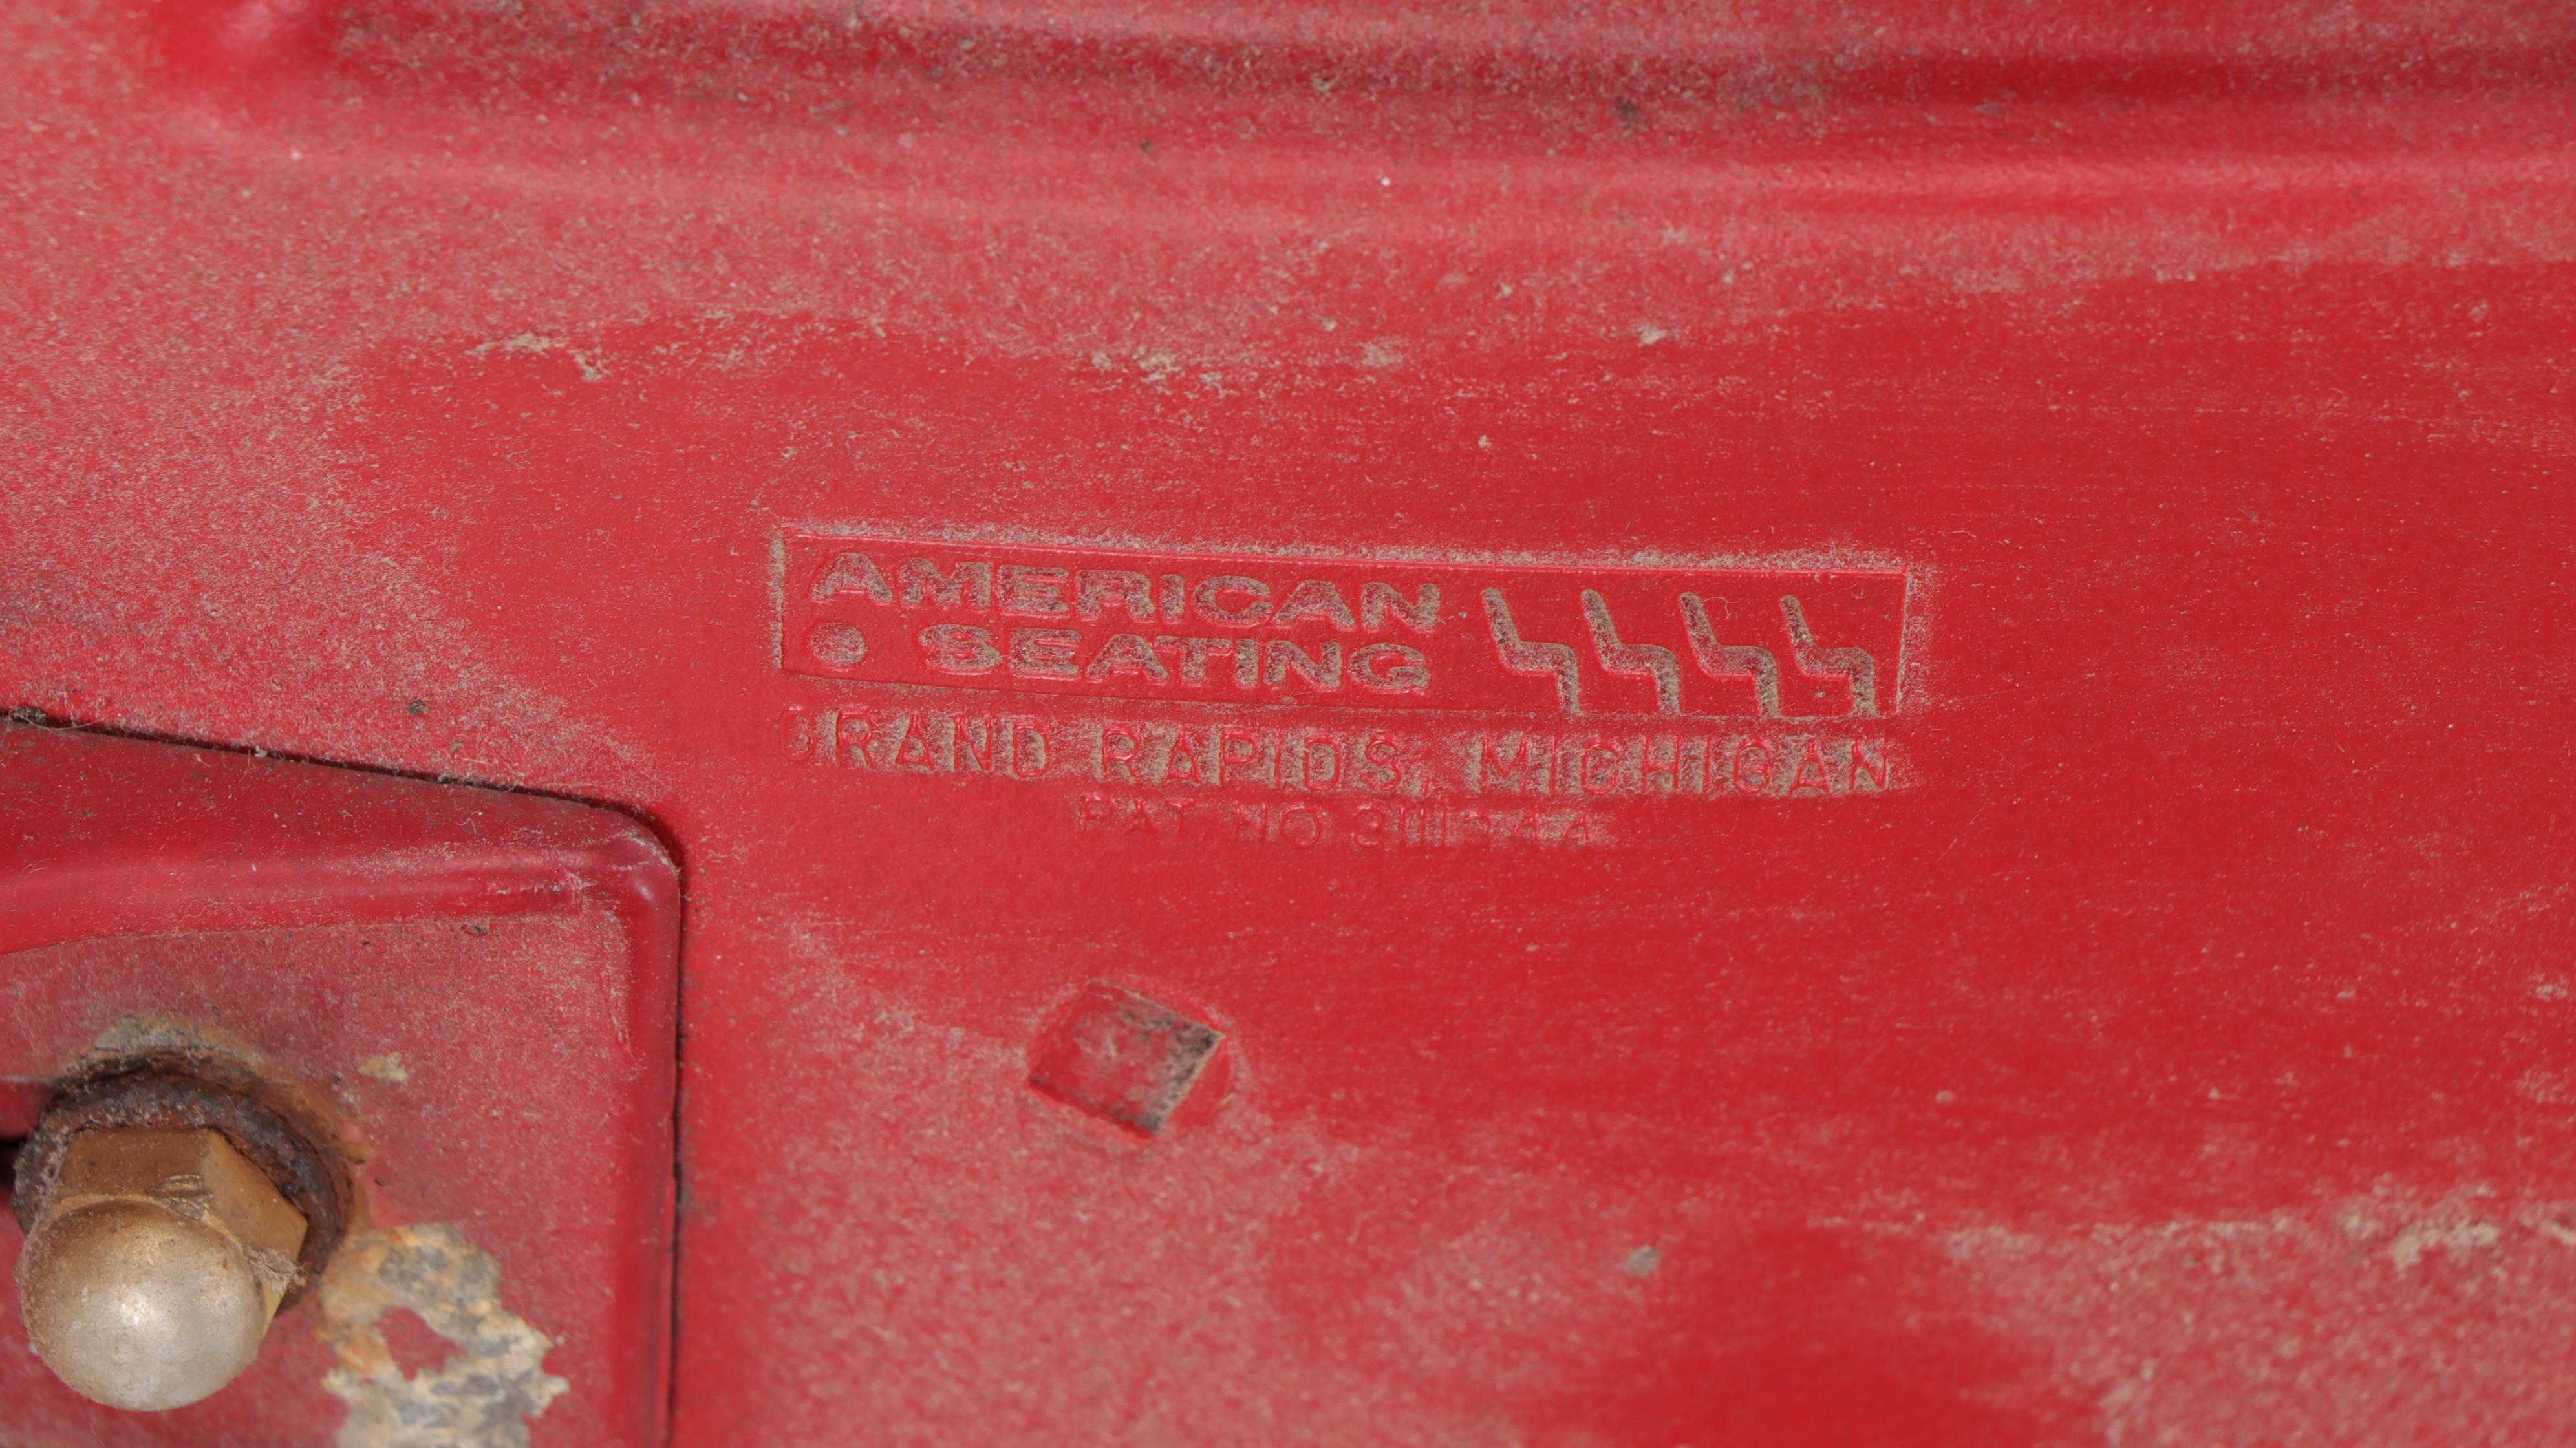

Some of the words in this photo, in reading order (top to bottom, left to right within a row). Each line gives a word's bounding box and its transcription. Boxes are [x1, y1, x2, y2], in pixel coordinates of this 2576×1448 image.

[810, 551, 1441, 632] AMERICAN
[919, 623, 1432, 696] SEATING
[1479, 734, 1889, 795] MICHIGAN
[1080, 793, 1197, 840] PAT
